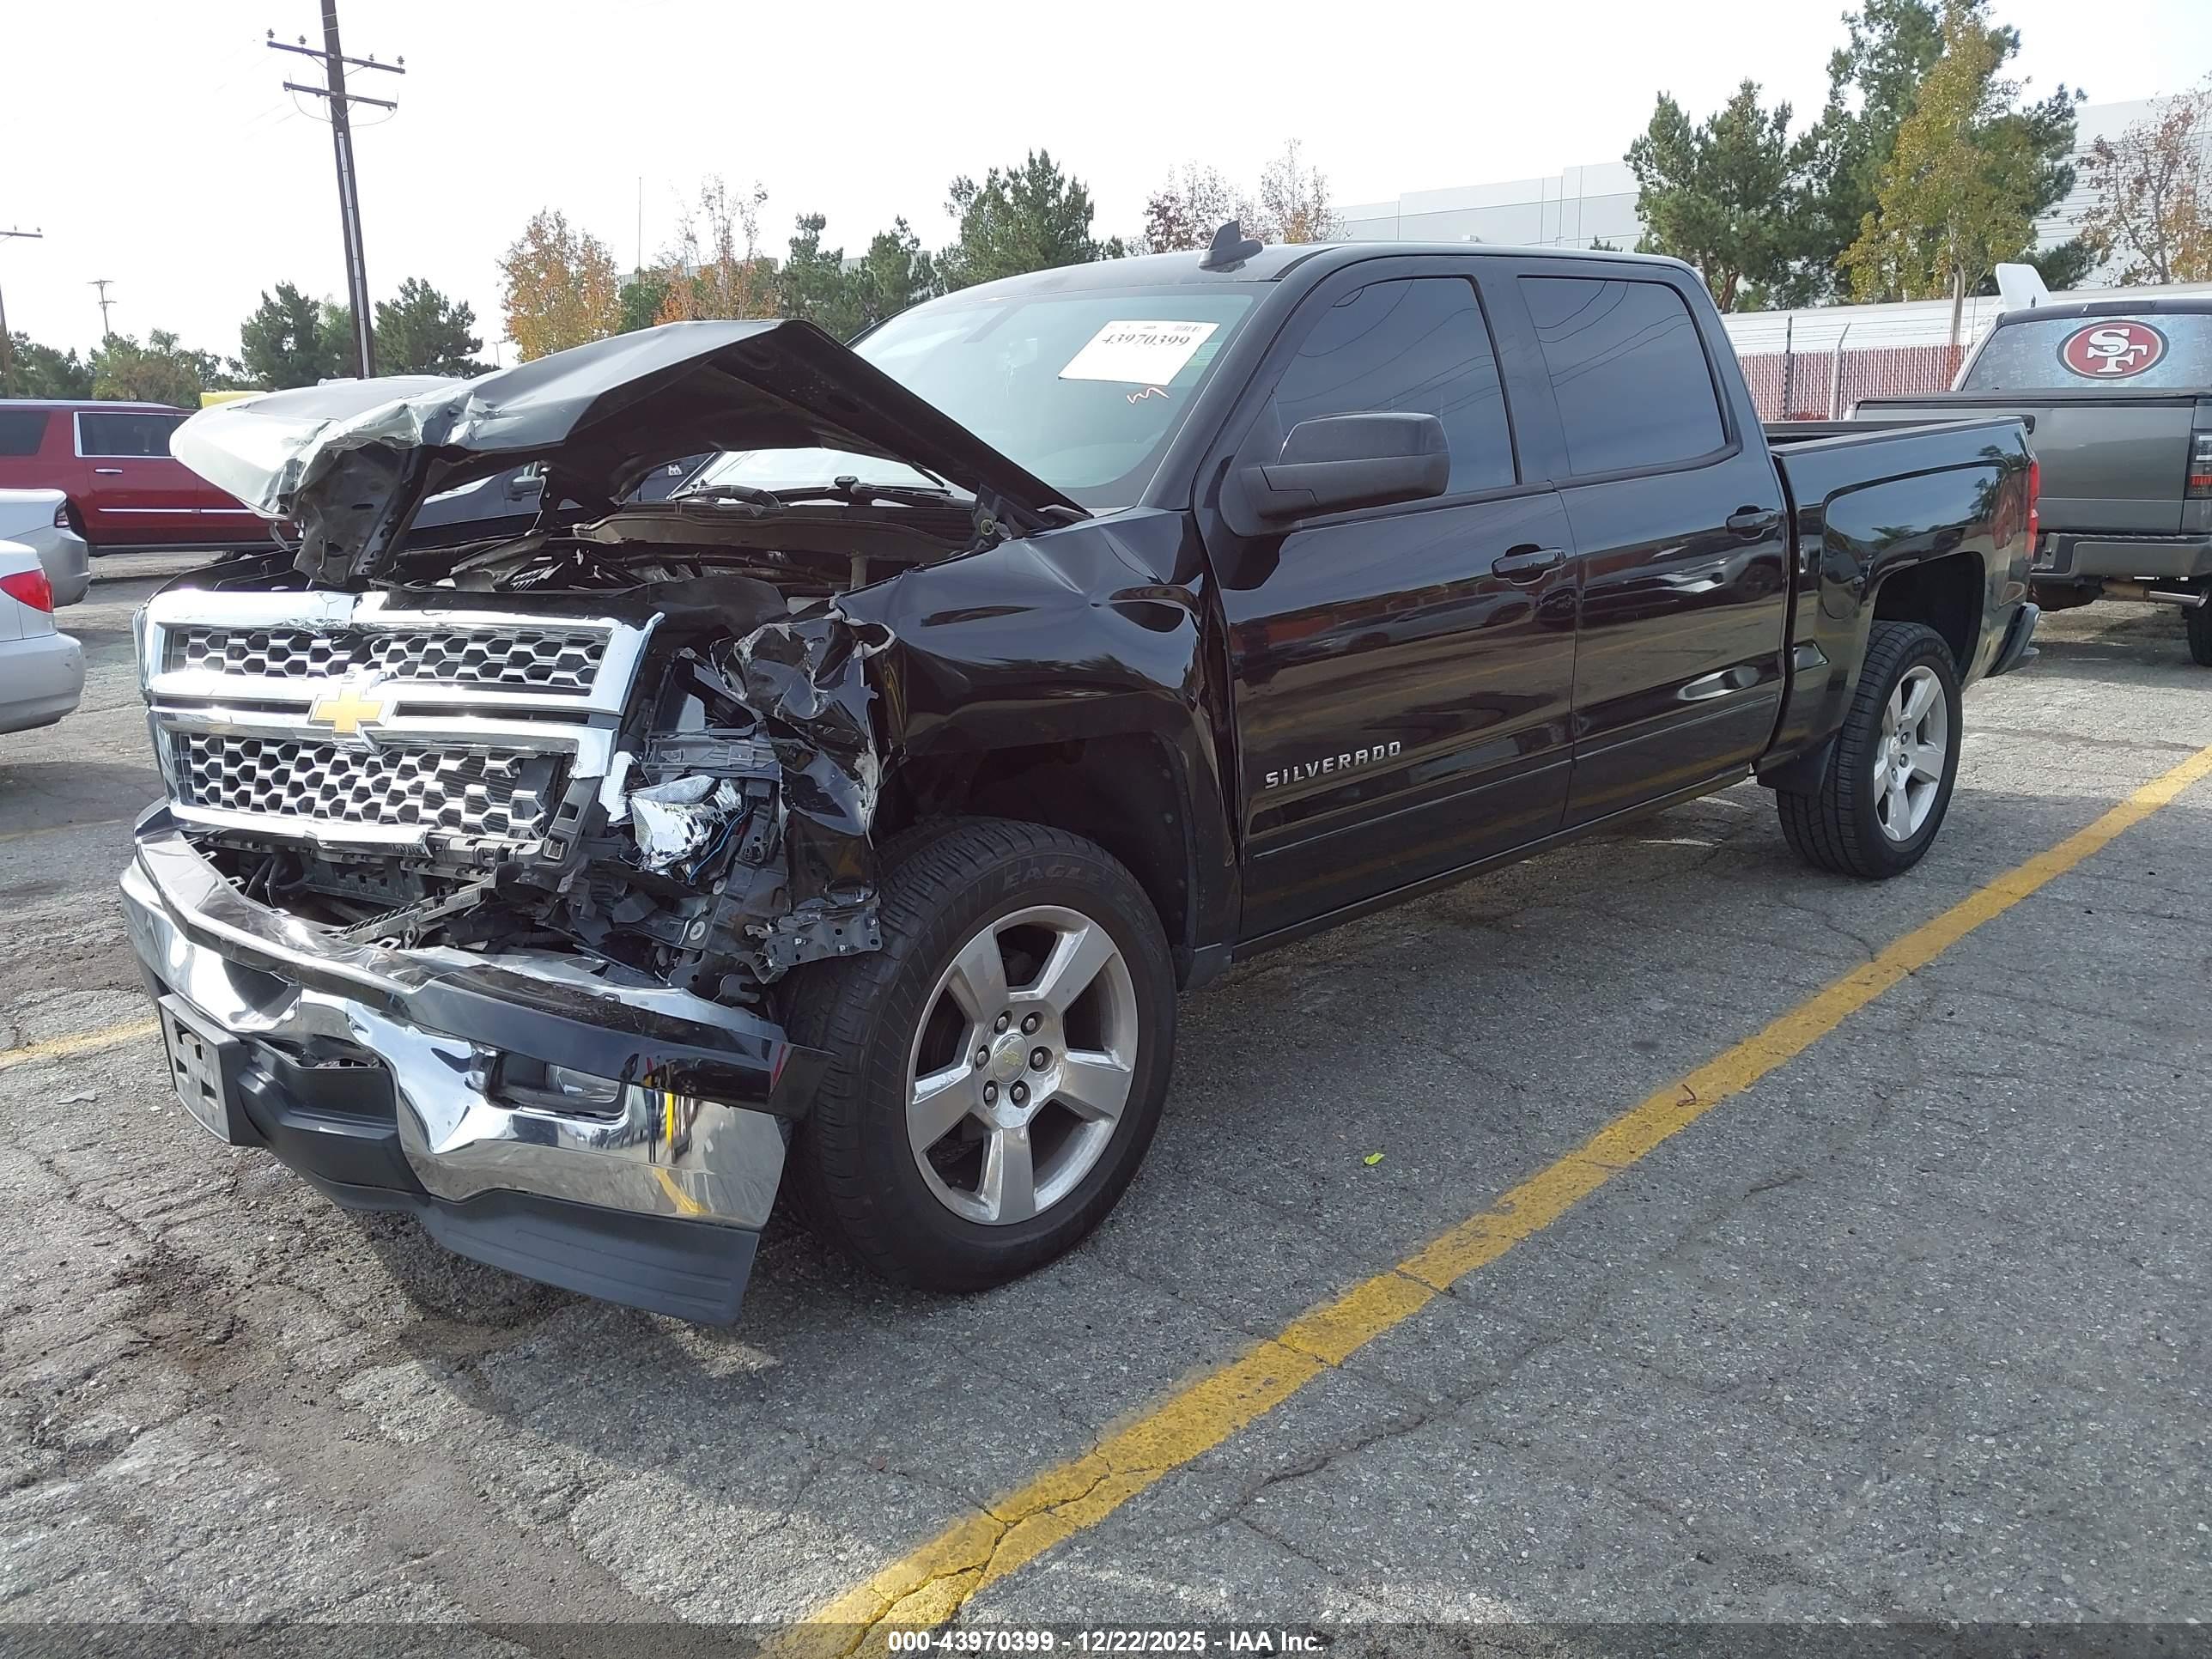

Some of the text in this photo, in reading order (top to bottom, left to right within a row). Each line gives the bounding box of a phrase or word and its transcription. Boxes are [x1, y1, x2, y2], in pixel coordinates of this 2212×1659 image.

[1102, 332, 1191, 347] 43970399
[1264, 740, 1401, 790] SILVERADO
[1003, 865, 1107, 891] EAGLE
